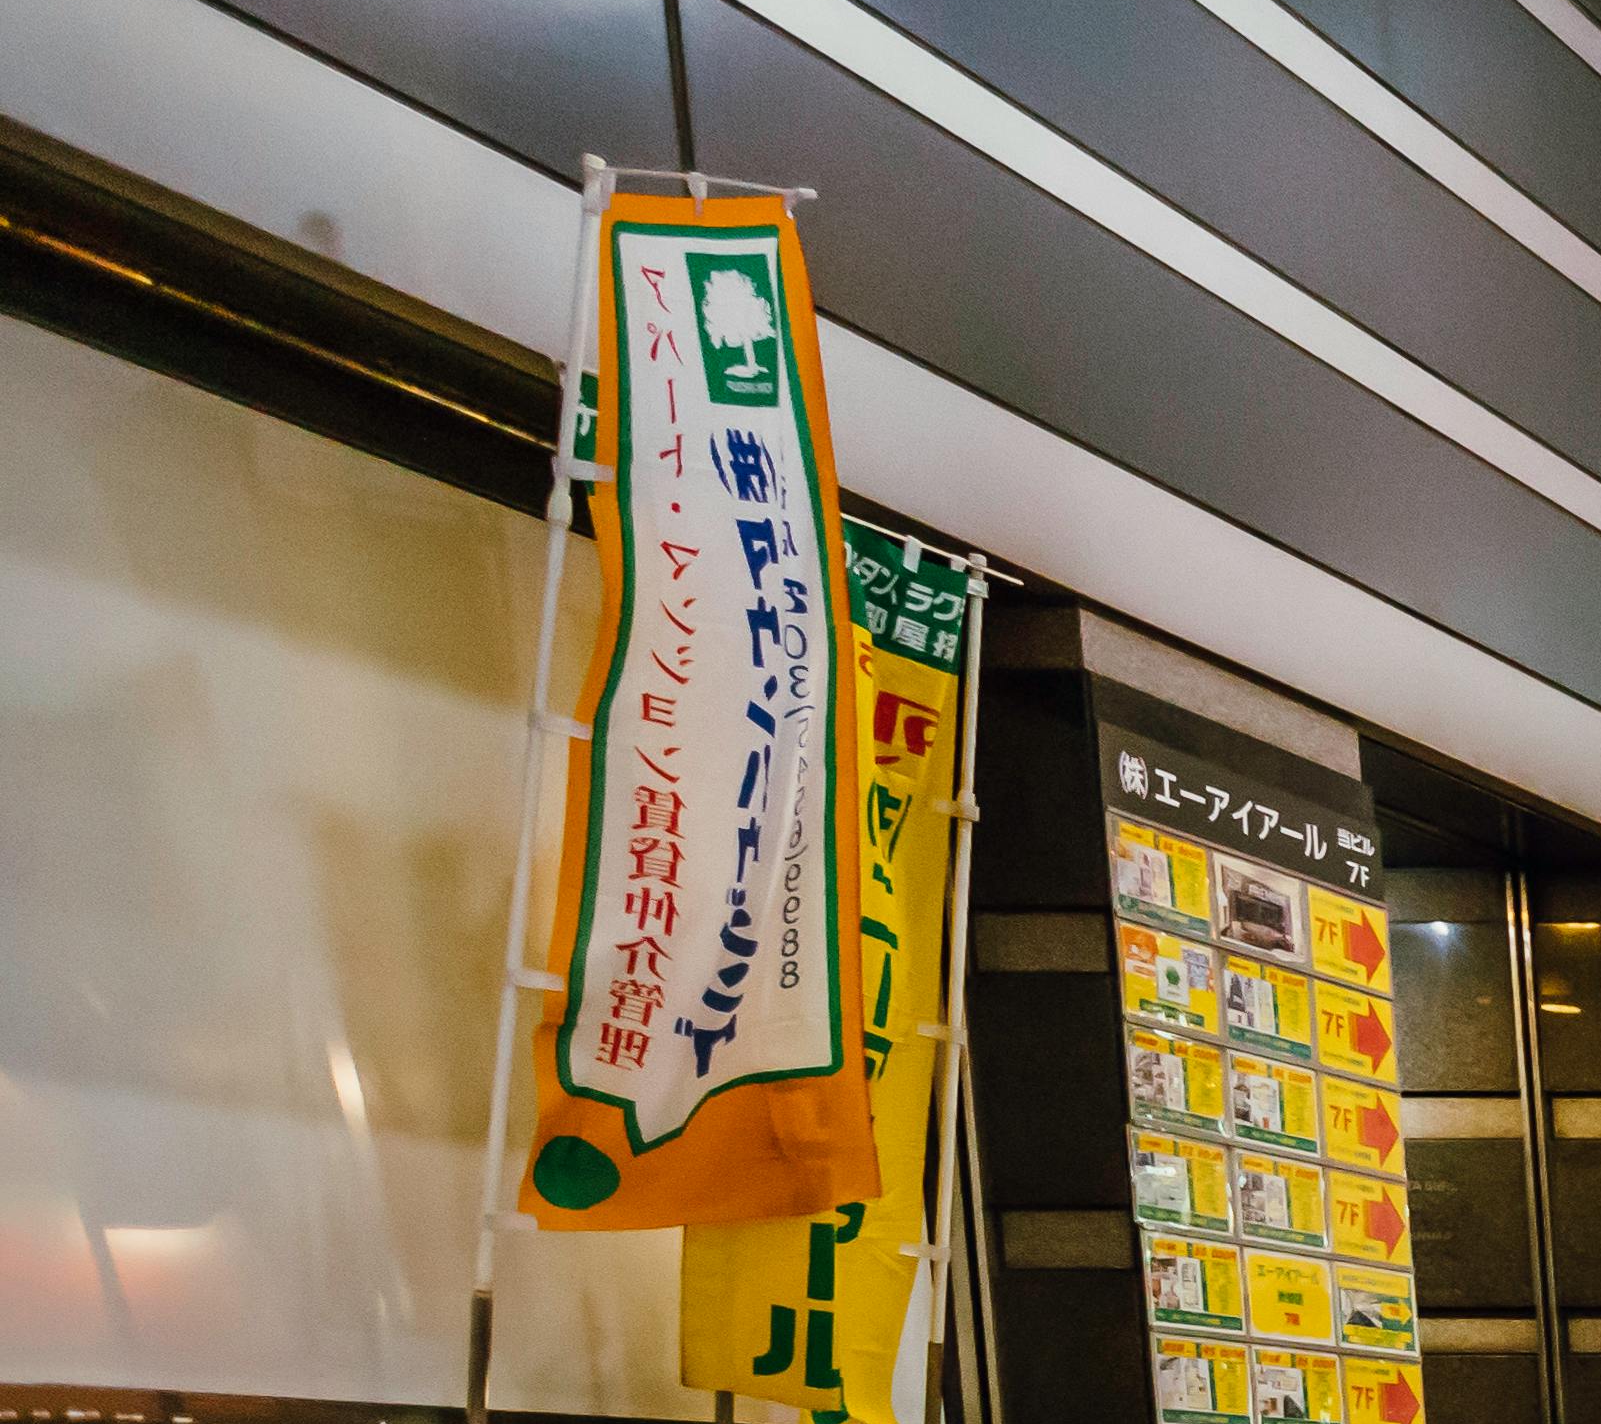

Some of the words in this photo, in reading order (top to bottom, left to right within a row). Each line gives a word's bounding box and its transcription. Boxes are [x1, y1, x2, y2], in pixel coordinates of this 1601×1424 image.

[1344, 860, 1371, 888] 7F
[1314, 916, 1339, 946] 7F
[1321, 1009, 1345, 1038] 7F
[1329, 1106, 1352, 1133] 7F
[1335, 1200, 1360, 1226] 7F
[1350, 1386, 1376, 1412] 7F
